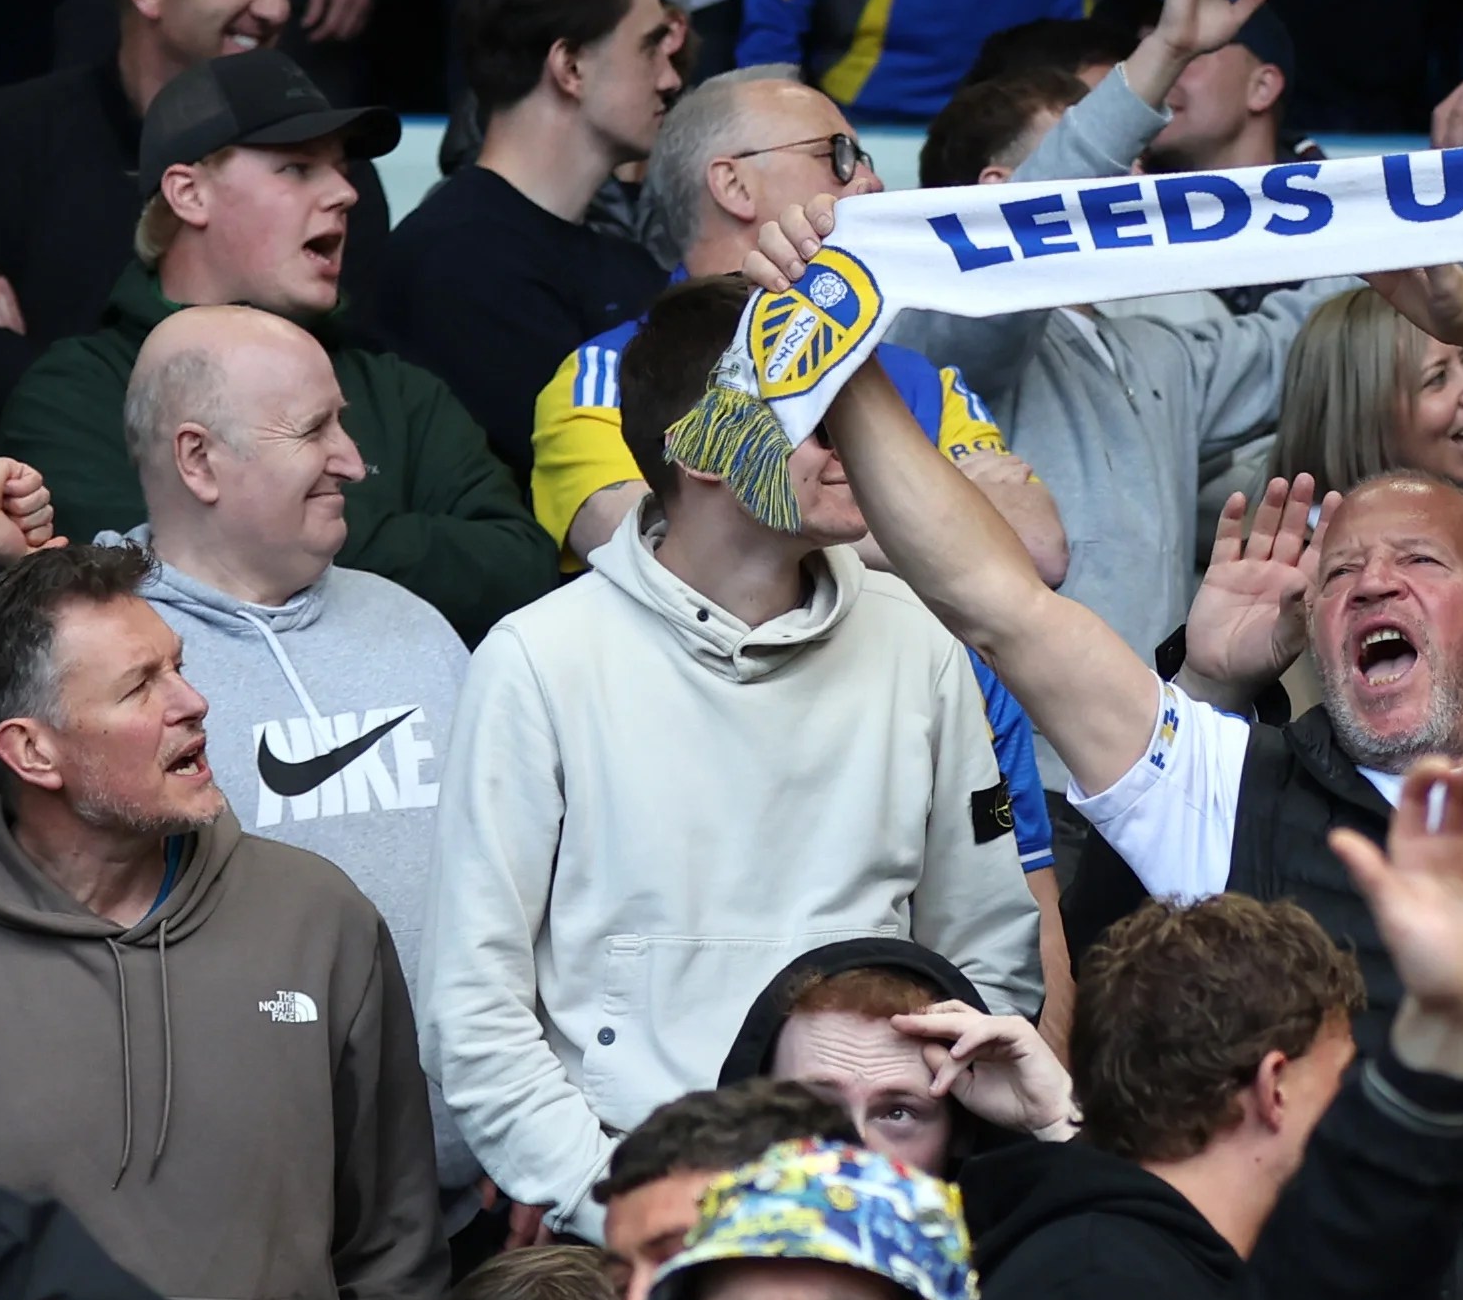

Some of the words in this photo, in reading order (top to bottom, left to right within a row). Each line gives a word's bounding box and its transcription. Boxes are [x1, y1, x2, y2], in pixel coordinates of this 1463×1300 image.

[927, 163, 1334, 273] LEEDS
[252, 704, 441, 828] NIKE
[276, 990, 295, 1002] THE
[258, 1000, 295, 1012] NORTH
[271, 1011, 295, 1022] FACE
